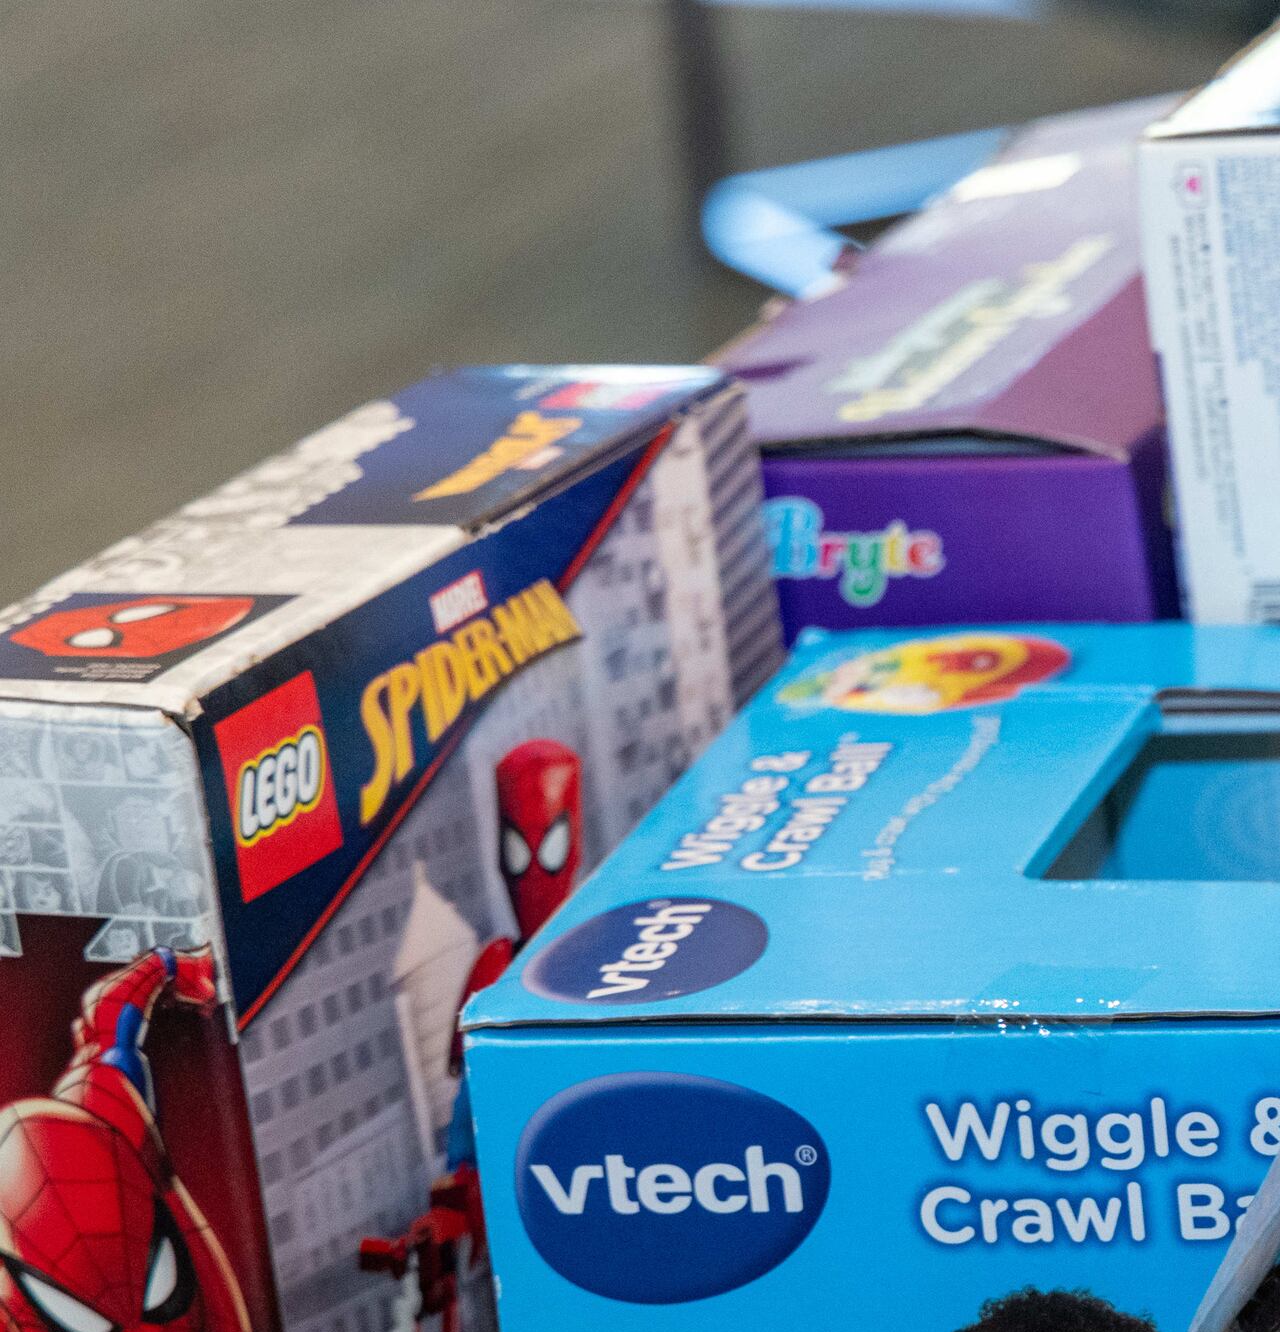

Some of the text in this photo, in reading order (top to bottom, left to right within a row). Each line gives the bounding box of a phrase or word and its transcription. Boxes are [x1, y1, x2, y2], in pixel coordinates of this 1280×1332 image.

[766, 497, 944, 606] Bryte
[359, 577, 584, 826] SPIDER-MAN
[238, 730, 322, 840] LEGO
[660, 751, 812, 872] Wiggle &
[740, 797, 849, 872] Crawl
[925, 1098, 1221, 1172] Wiggle
[919, 1180, 1147, 1246] Crawl
